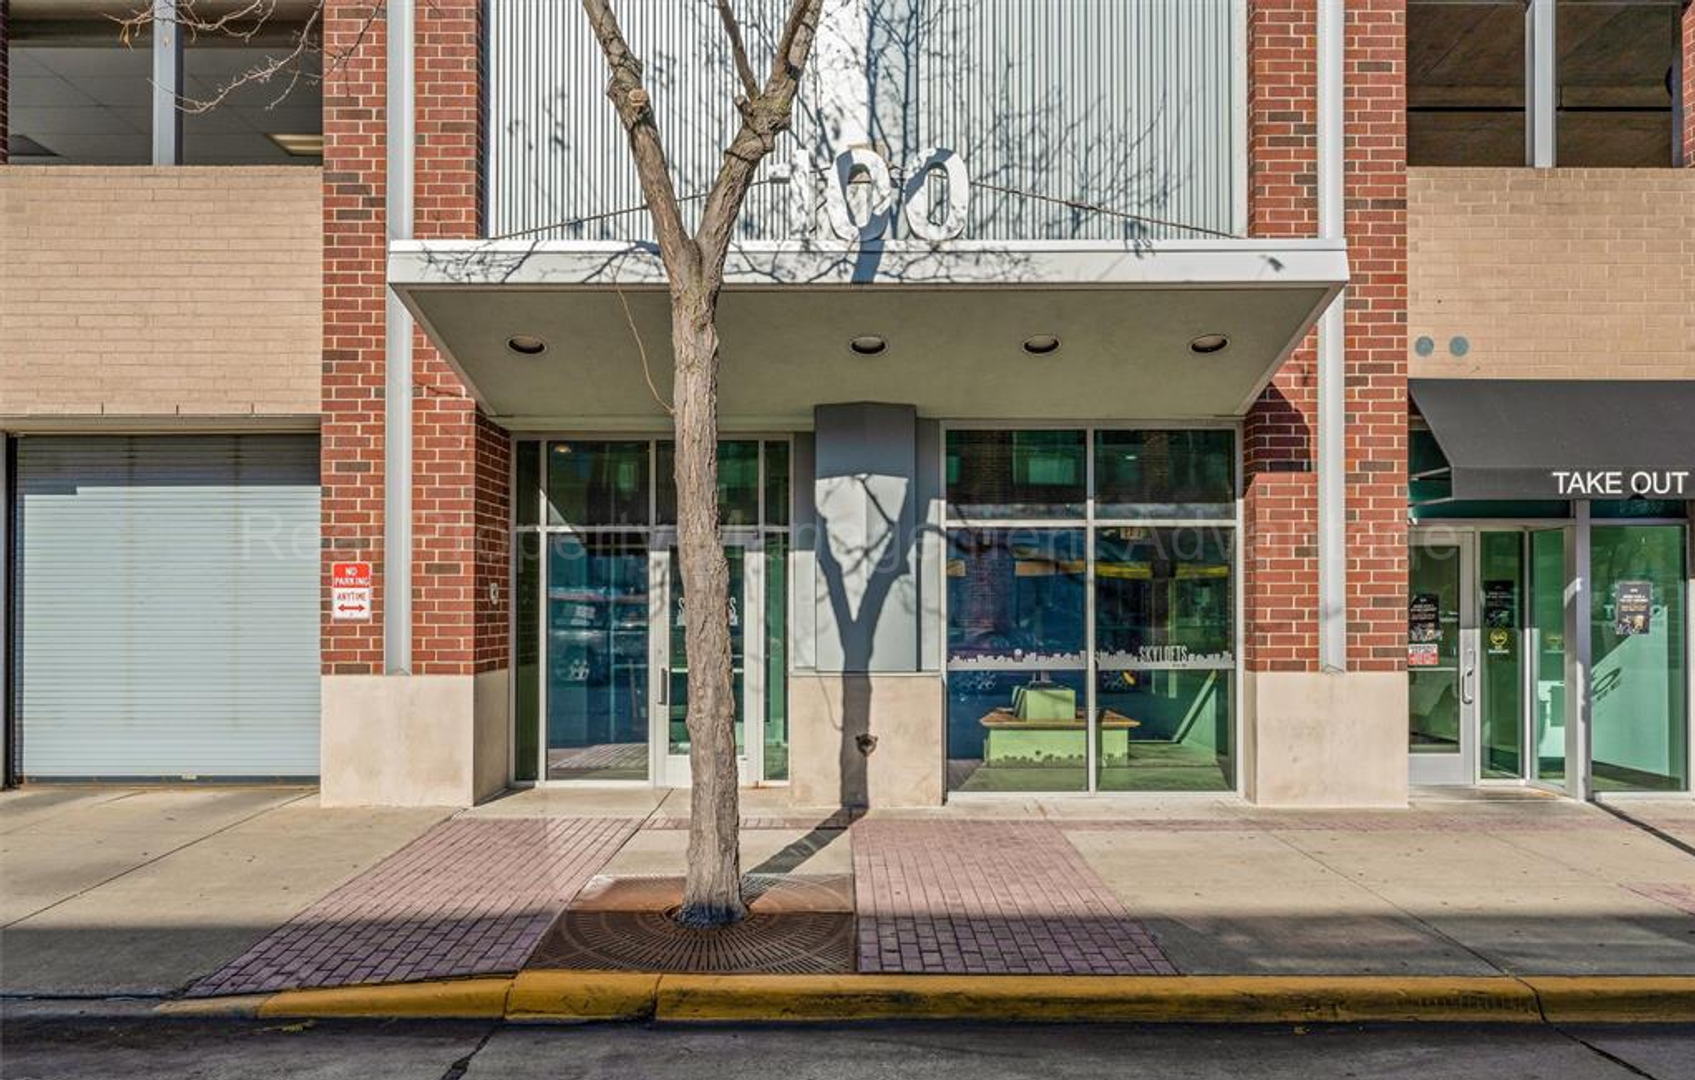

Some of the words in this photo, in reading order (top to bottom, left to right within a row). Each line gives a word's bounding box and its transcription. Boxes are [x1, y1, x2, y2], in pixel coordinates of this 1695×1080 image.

[1552, 471, 1623, 495] TAKE
[1630, 471, 1690, 495] OUT
[344, 566, 358, 576] NO
[334, 576, 371, 586] PARKING
[336, 591, 367, 601] ANYTIME
[1138, 645, 1188, 663] SKYLOFTS
